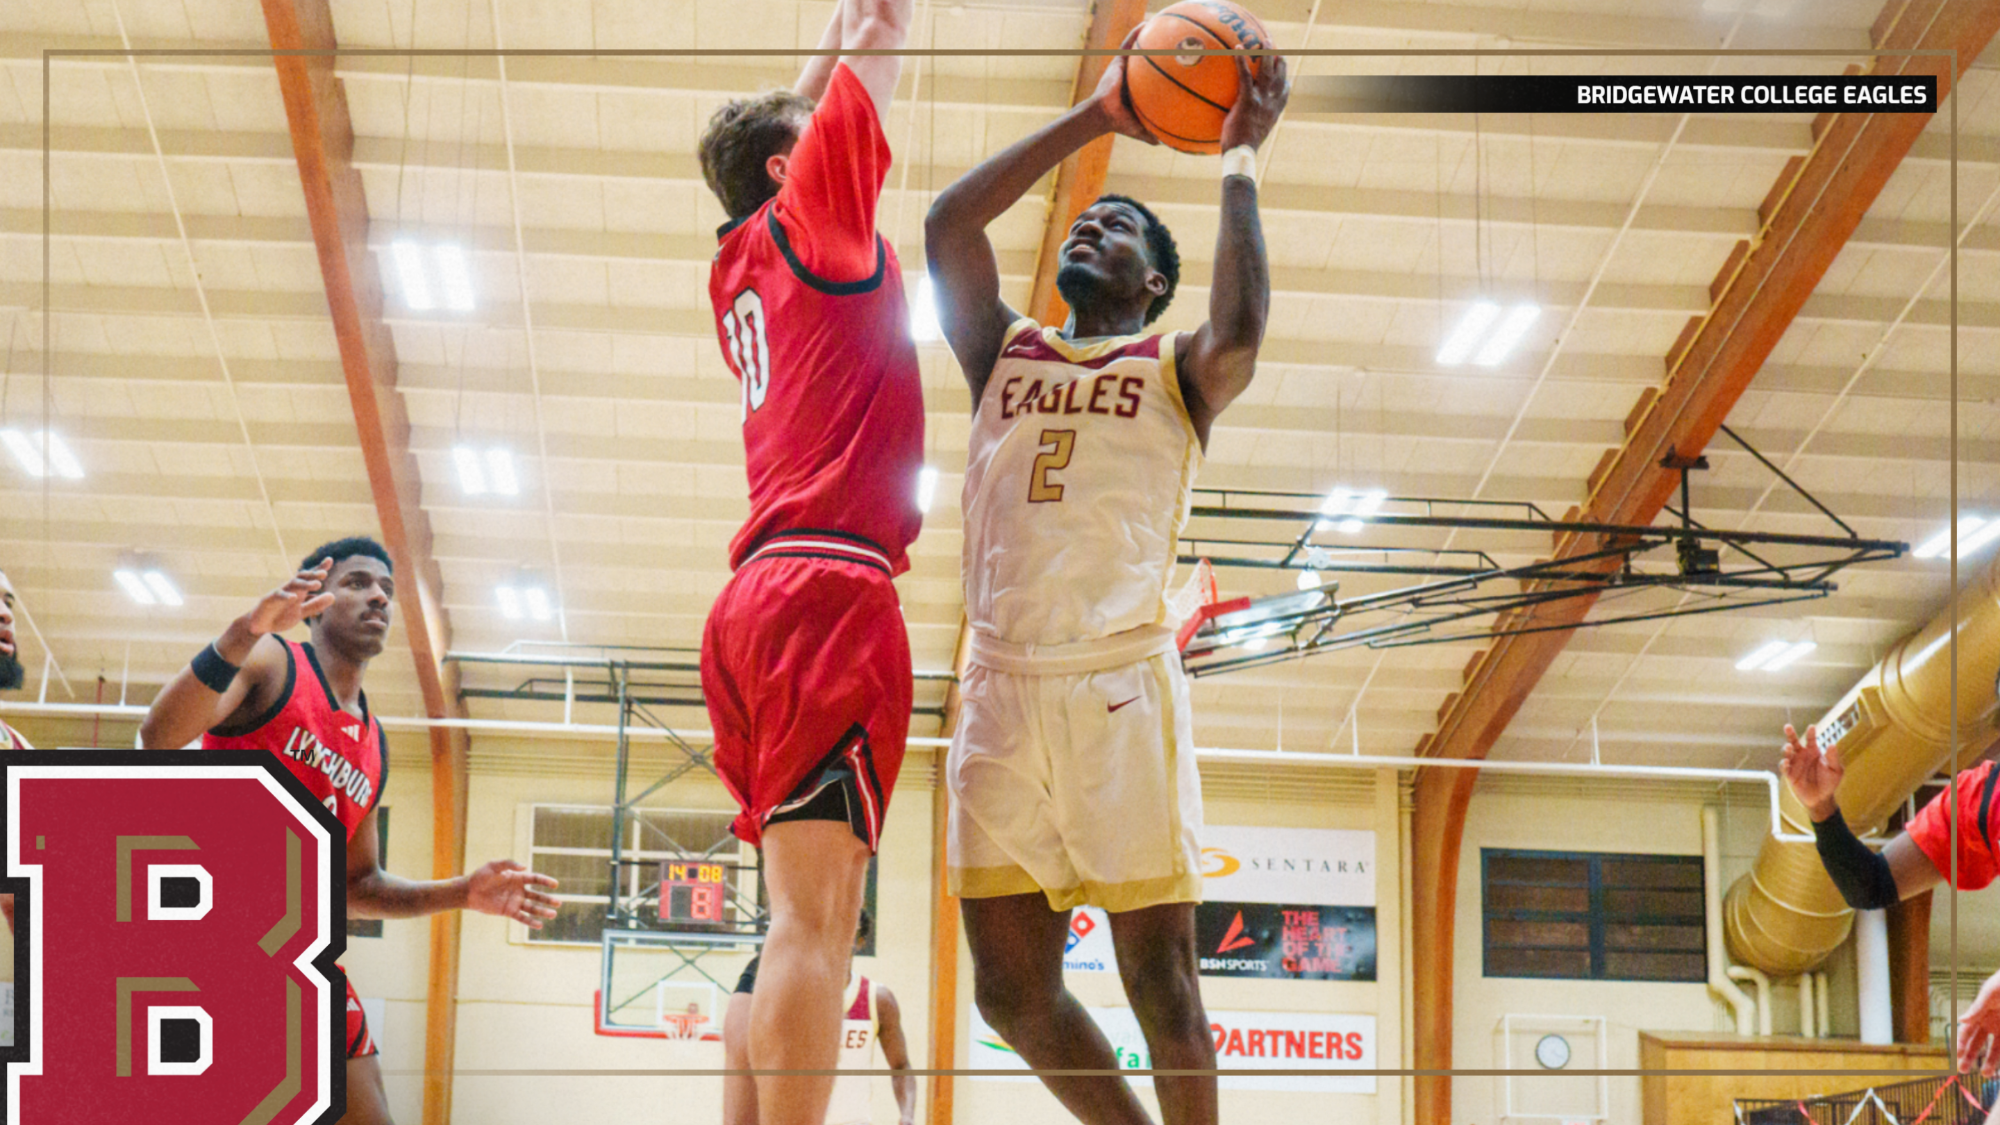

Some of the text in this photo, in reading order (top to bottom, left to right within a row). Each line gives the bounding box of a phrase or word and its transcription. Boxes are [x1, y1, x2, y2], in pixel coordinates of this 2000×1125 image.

[722, 285, 770, 426] 10
[1002, 374, 1144, 419] EAGLES
[1027, 428, 1077, 503] 2
[282, 725, 373, 809] LYNCHBUR
[1252, 858, 1366, 873] SENTARA
[690, 886, 713, 919] 8
[1281, 910, 1319, 926] THE
[1281, 926, 1347, 942] HEART
[1282, 942, 1309, 957] OF
[1062, 958, 1105, 971] mino's
[1281, 957, 1343, 973] GAME
